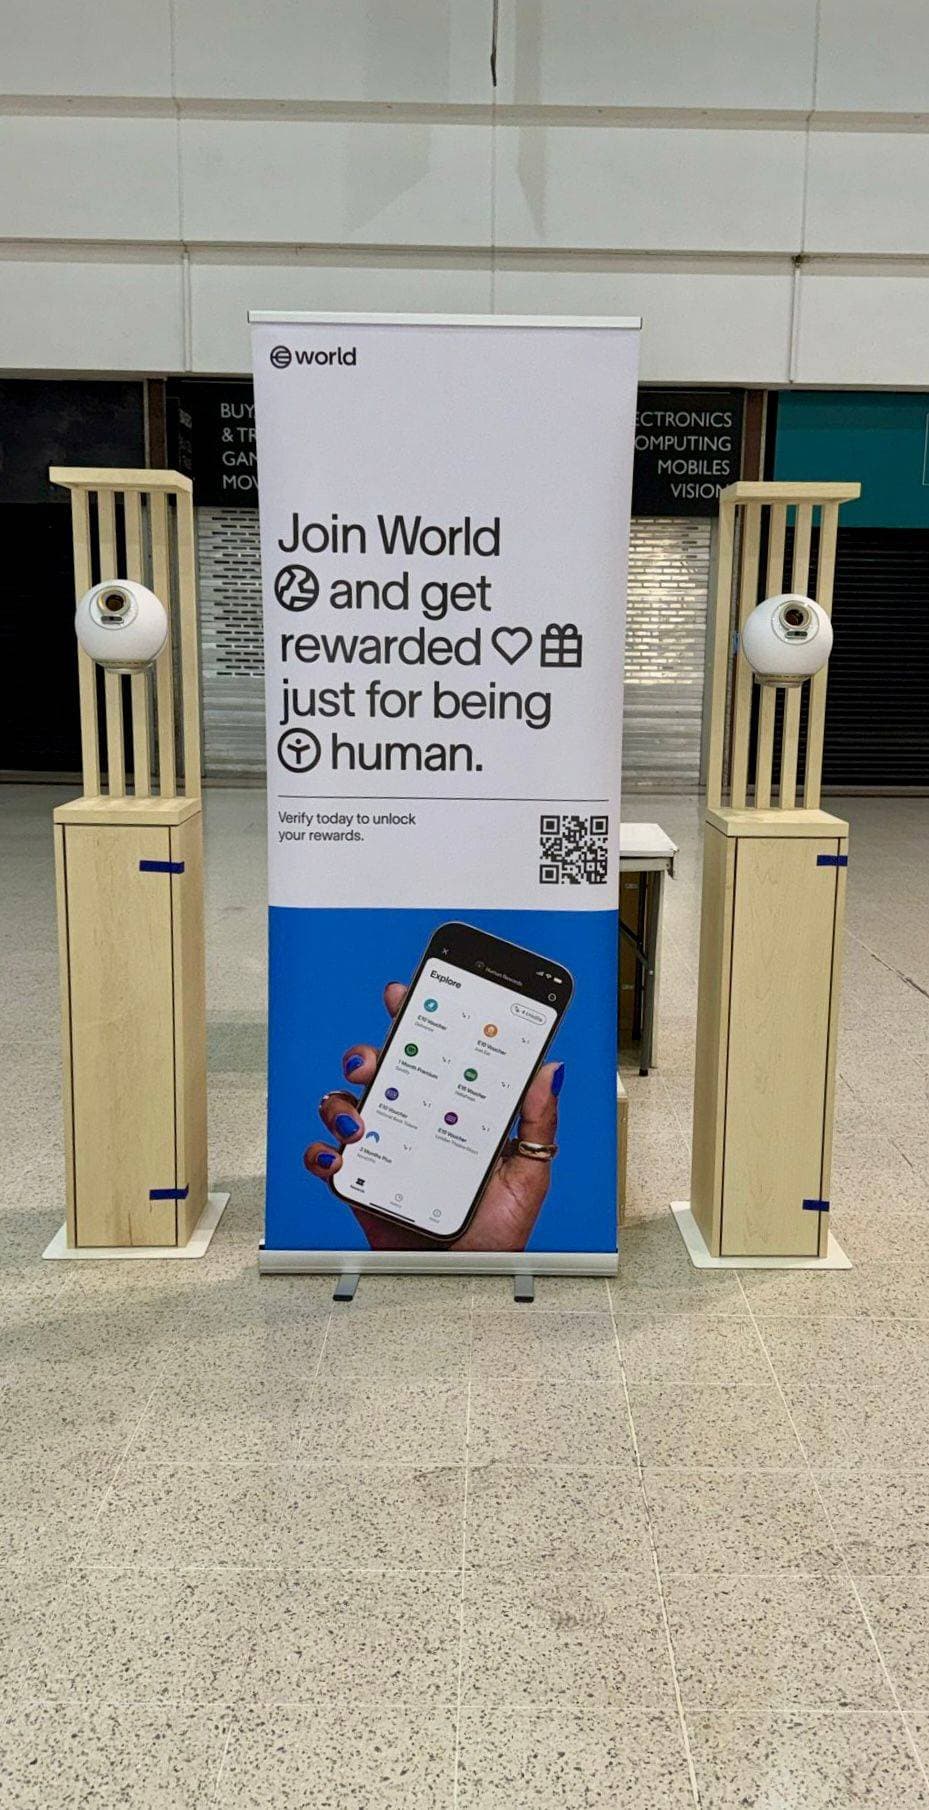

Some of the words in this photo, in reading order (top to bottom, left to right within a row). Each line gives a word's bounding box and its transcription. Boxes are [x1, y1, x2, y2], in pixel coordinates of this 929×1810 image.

[294, 346, 357, 366] world
[222, 427, 234, 442] &
[658, 460, 730, 475] MOBILES
[278, 513, 366, 554] Join
[377, 515, 501, 557] World
[330, 571, 409, 611] and
[421, 575, 492, 621] get
[281, 627, 482, 666] rewarded
[279, 678, 356, 726] just
[366, 679, 423, 719] for
[433, 681, 552, 730] being
[332, 733, 483, 772] human.
[278, 811, 314, 827] Verify
[316, 812, 354, 828] today
[356, 813, 370, 825] to
[372, 812, 417, 825] unlock
[278, 830, 307, 844] your
[309, 829, 365, 842] rewards.
[430, 970, 462, 990] Explore
